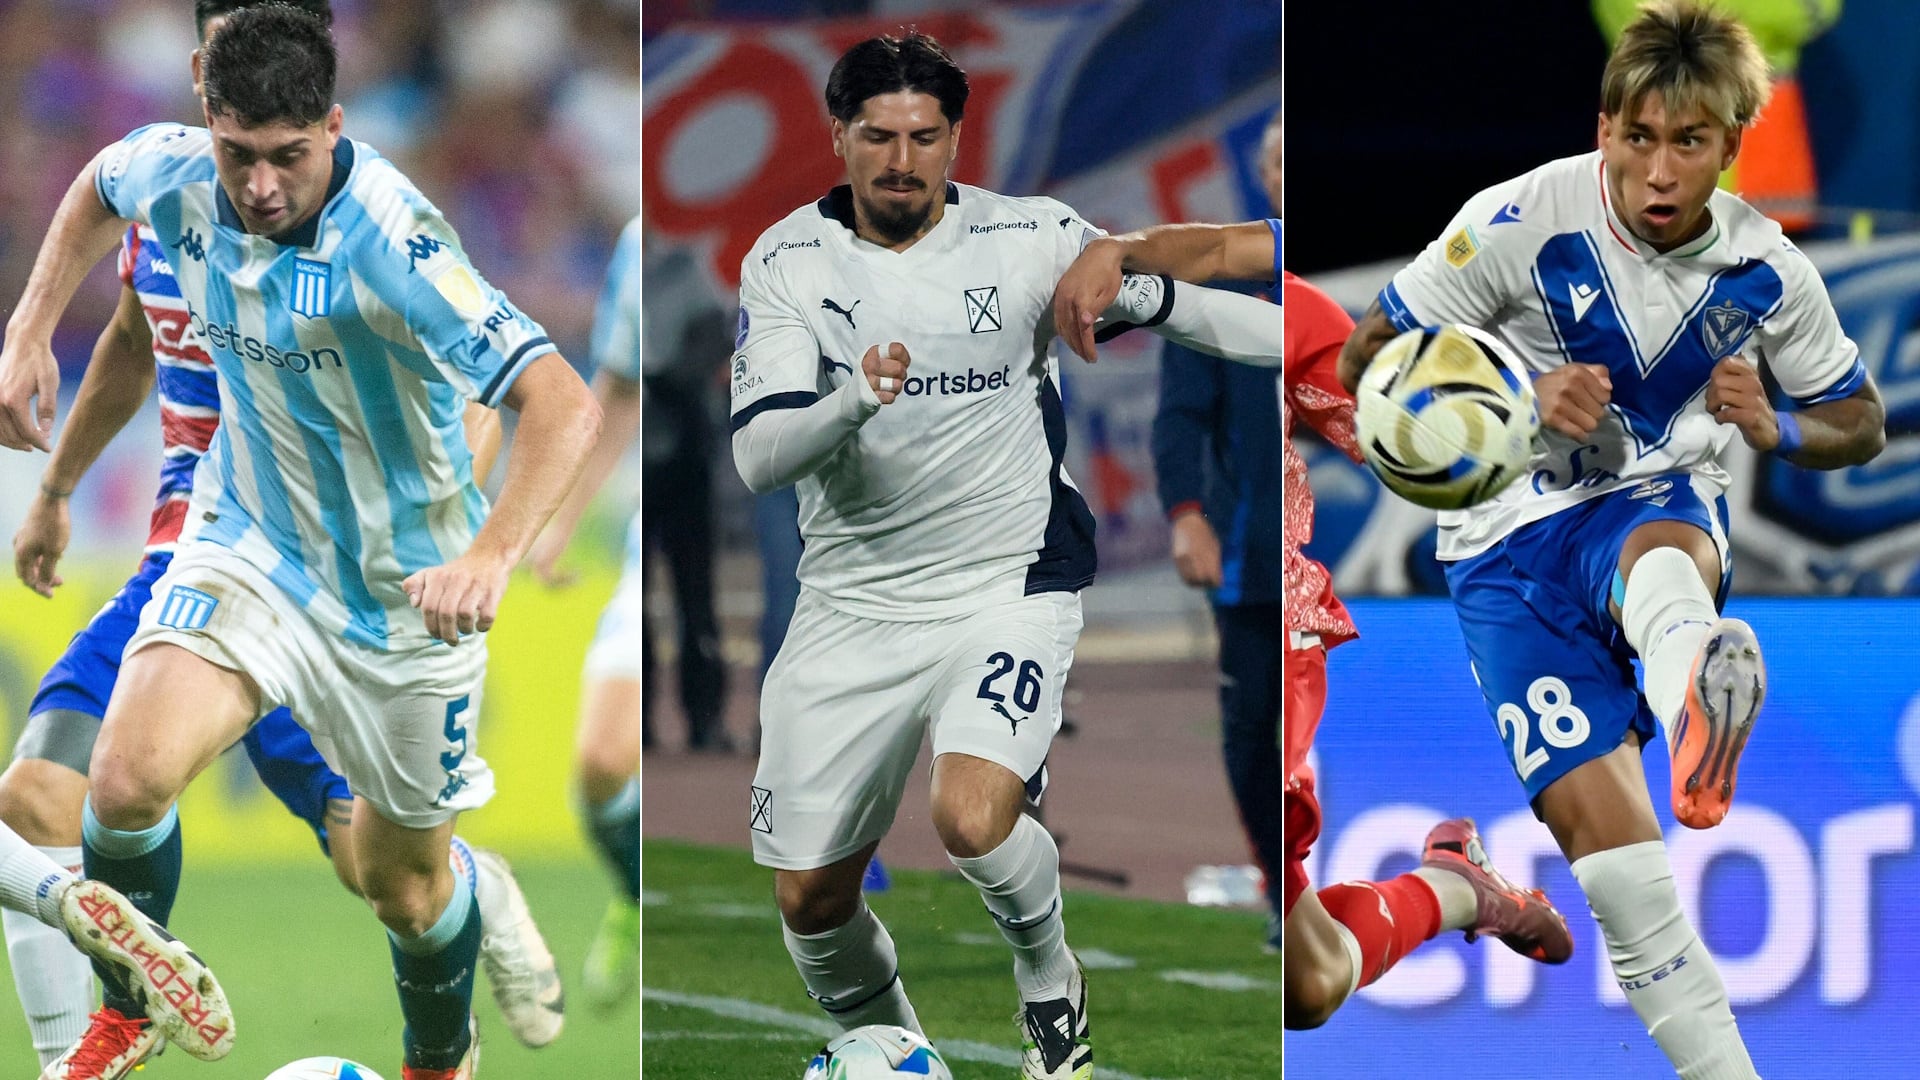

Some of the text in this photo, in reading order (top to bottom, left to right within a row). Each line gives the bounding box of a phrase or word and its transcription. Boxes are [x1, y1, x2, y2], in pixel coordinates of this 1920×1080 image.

[295, 261, 328, 275] RACING
[187, 300, 343, 374] betsson
[903, 364, 1010, 396] ortsbet
[172, 586, 214, 605] RACING
[976, 651, 1043, 713] 26
[439, 693, 470, 772] 5
[1497, 676, 1591, 782] 28
